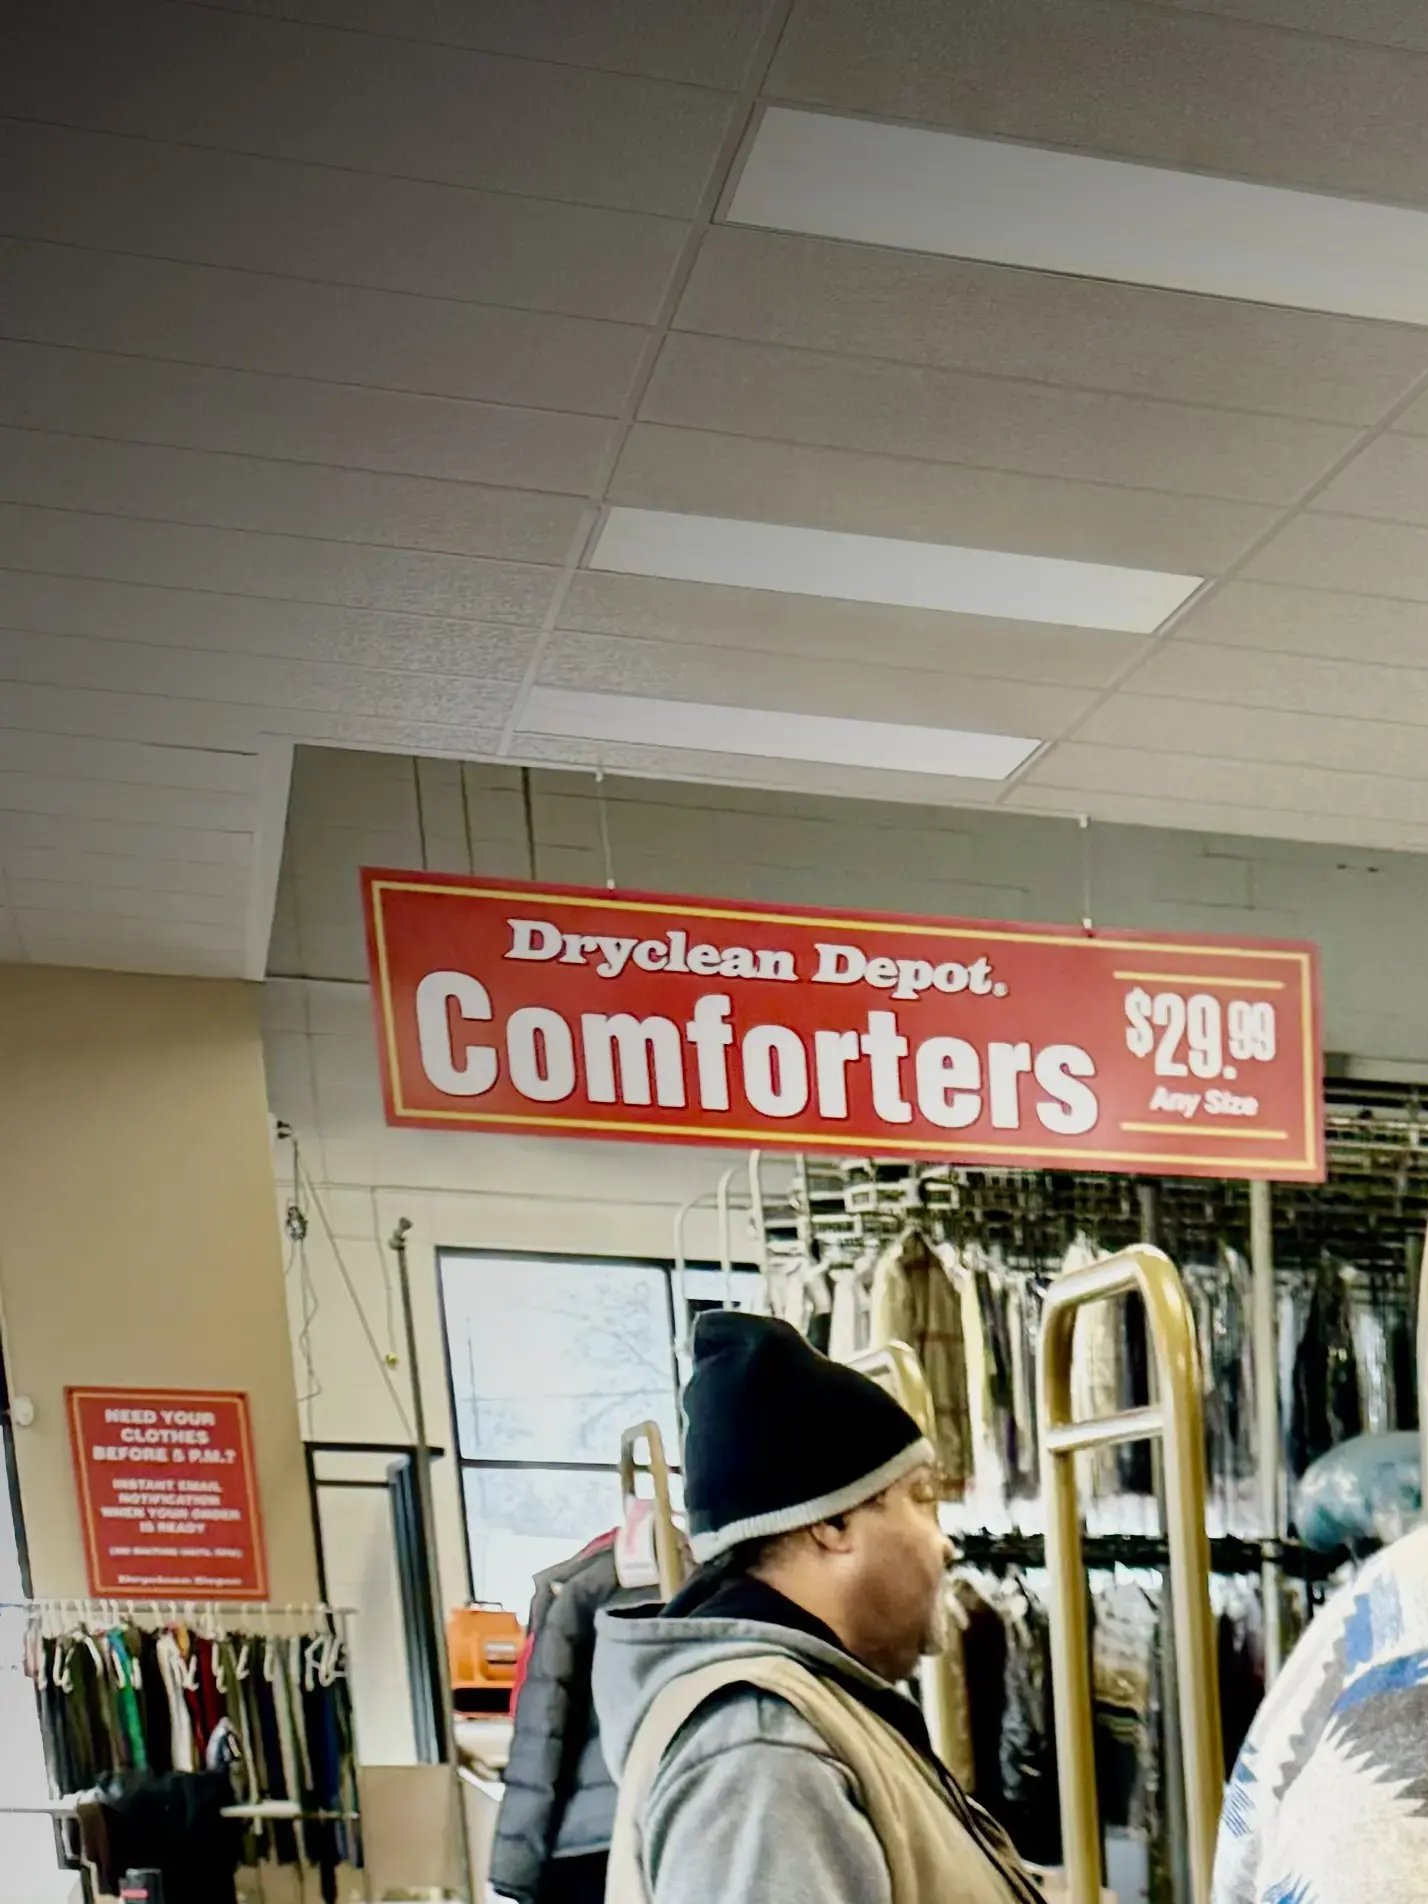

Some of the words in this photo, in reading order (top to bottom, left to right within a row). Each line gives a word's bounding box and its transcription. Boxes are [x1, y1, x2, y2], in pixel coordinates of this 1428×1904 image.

[503, 917, 799, 982] Dryclean
[1124, 986, 1276, 1080] $29.99
[414, 968, 1100, 1136] Comforters
[1149, 1084, 1202, 1119] Any
[1203, 1088, 1260, 1117] Size
[104, 1408, 157, 1424] NEED
[160, 1410, 216, 1426] YOUR
[92, 1444, 169, 1462] BEFORE
[120, 1427, 210, 1445] CLOTHES
